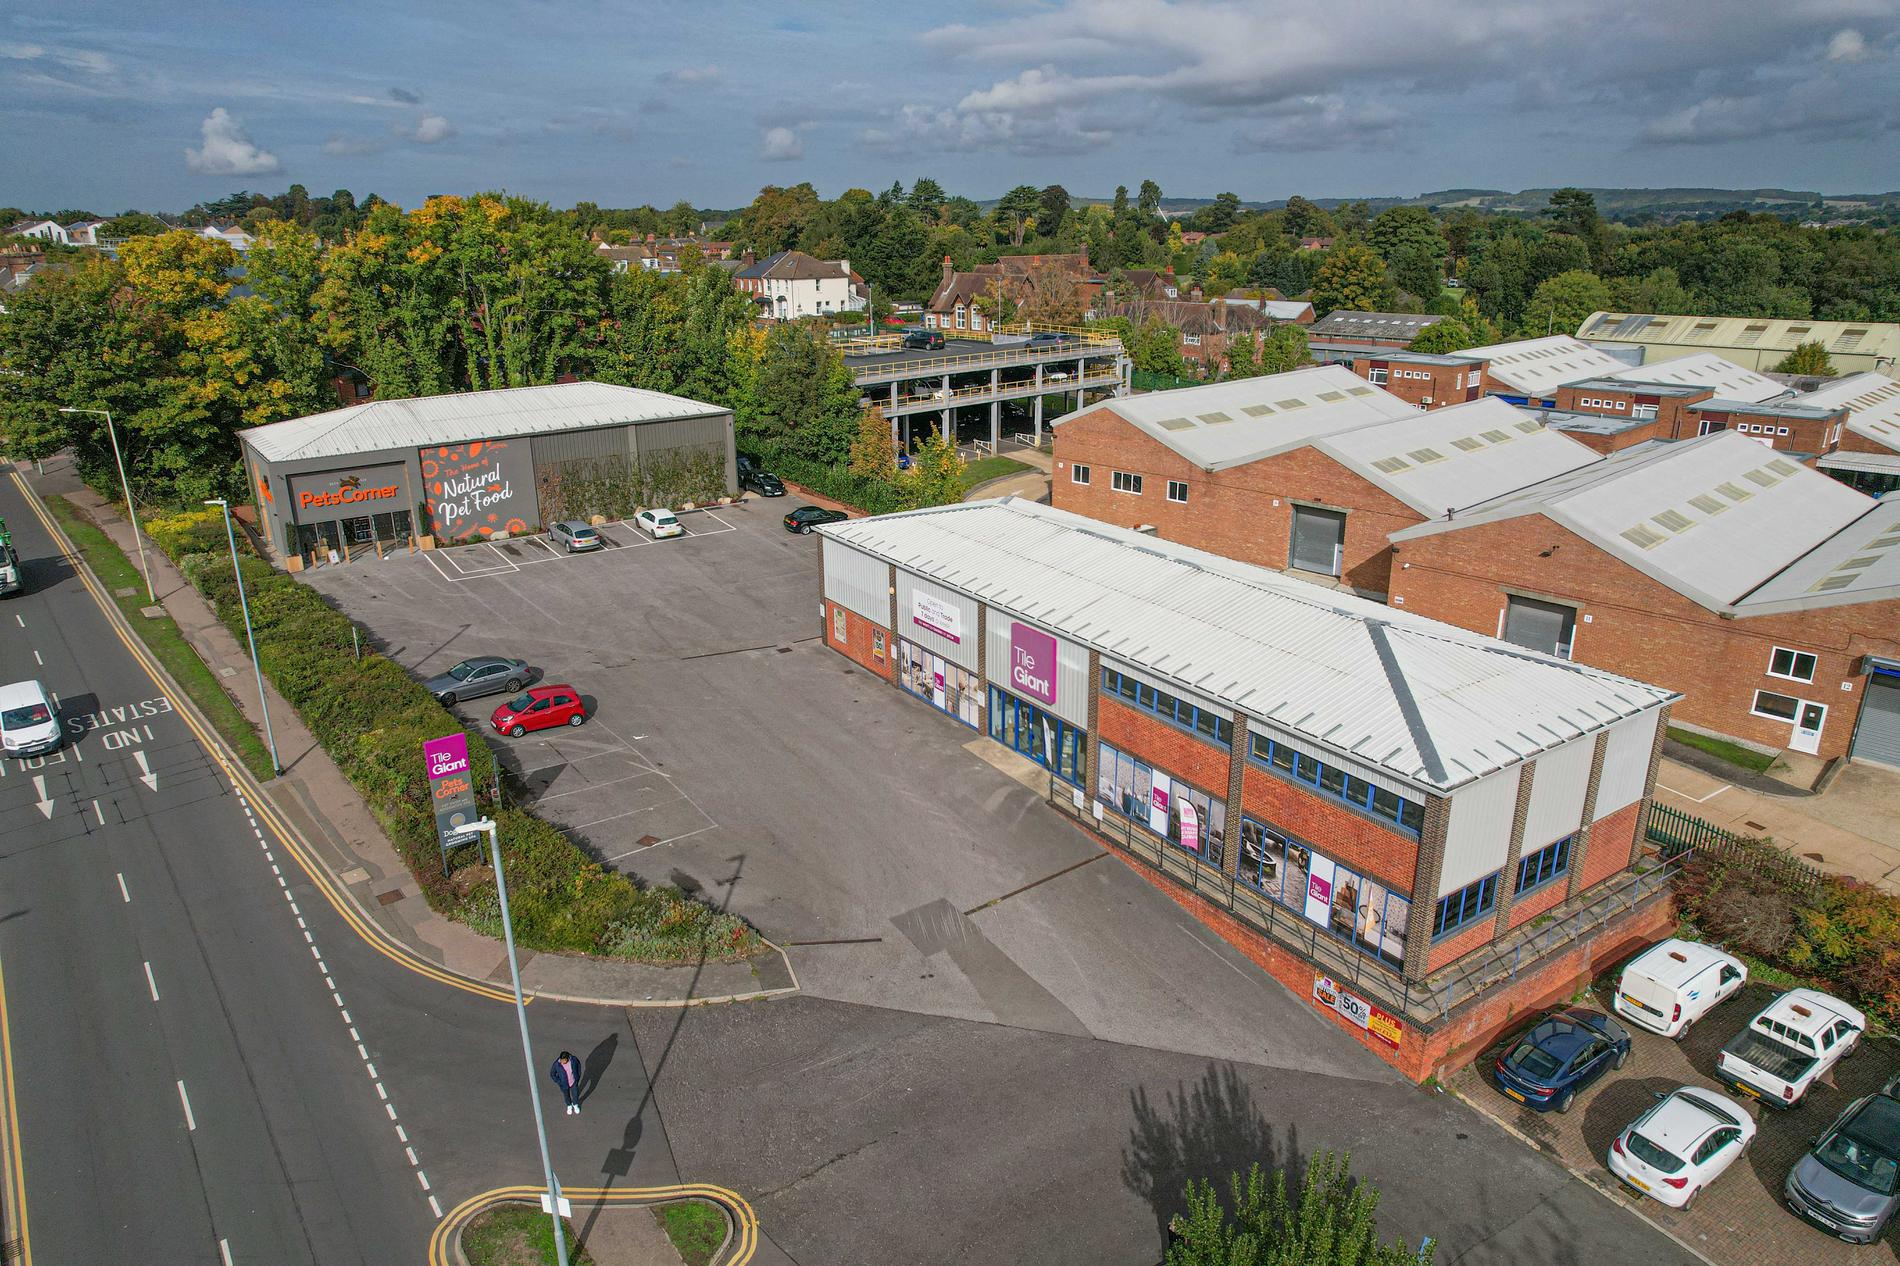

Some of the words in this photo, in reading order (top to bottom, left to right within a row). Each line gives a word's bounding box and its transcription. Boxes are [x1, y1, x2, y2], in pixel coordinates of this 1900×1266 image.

[444, 462, 500, 499] Natural
[300, 485, 400, 509] PetsCorner
[438, 496, 472, 526] Pet
[470, 480, 513, 512] Food
[1014, 645, 1036, 670] Tile
[1013, 665, 1050, 697] Giant
[67, 696, 173, 734] ESTATES
[102, 724, 154, 750] IND
[430, 752, 452, 765] Tile
[432, 758, 467, 775] Giant
[435, 783, 469, 799] Corner
[441, 778, 463, 790] Pets
[1311, 881, 1322, 893] Tile
[1310, 888, 1329, 904] Giant
[1317, 989, 1337, 1004] SALE
[1376, 1012, 1397, 1027] PLUS
